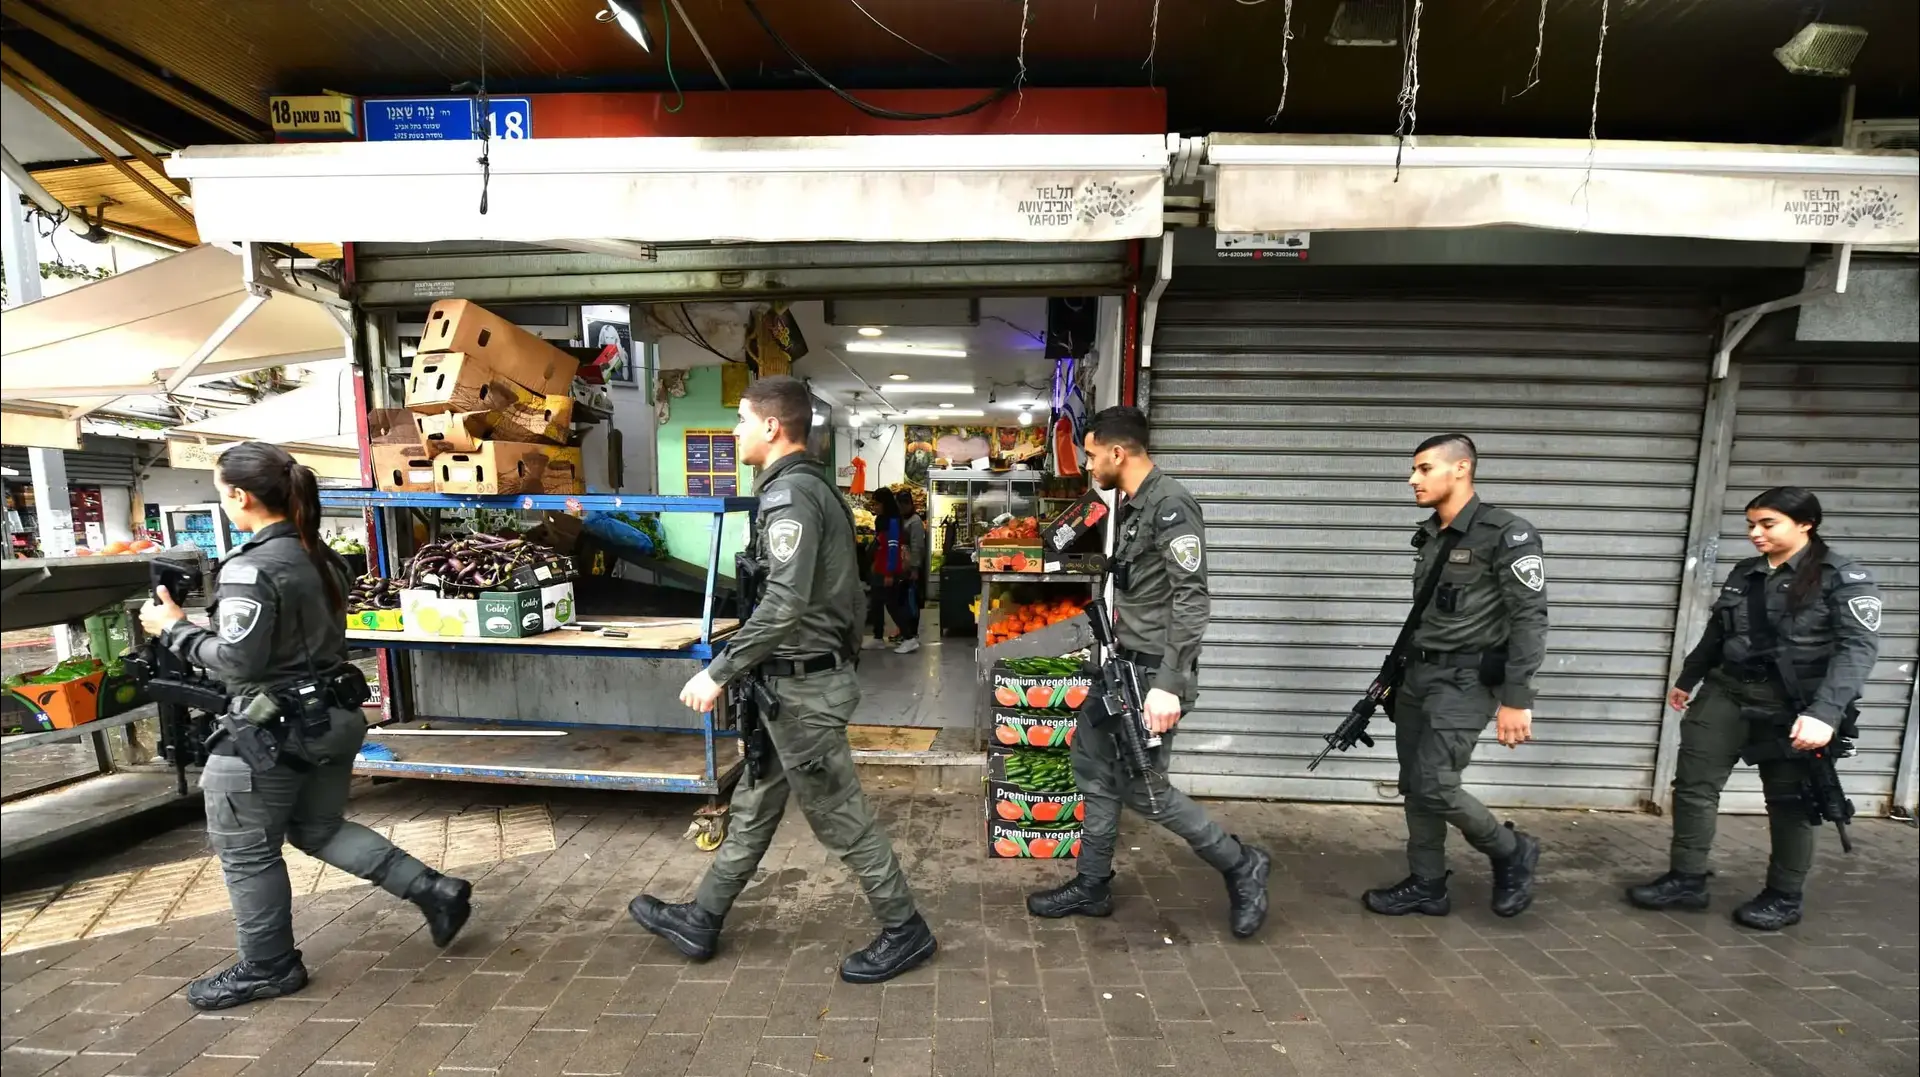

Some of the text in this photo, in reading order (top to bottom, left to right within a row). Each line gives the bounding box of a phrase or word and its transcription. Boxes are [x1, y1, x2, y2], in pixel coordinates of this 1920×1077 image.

[272, 100, 341, 127] נוה שאנן 18
[485, 111, 524, 140] 18
[1036, 184, 1073, 199] TEL תל
[1803, 187, 1840, 201] TEL תל
[1018, 201, 1073, 213] AVIV אביב
[1783, 202, 1840, 213] AVIV אביב
[1028, 214, 1073, 226] YAFO יפו
[1794, 214, 1839, 226] YAFO יפו
[485, 603, 512, 615] Goldy
[521, 597, 539, 608] Goldy
[994, 674, 1092, 689] Premium vegetables
[37, 714, 49, 722] 36
[995, 713, 1038, 726] Premium
[996, 788, 1086, 804] Premium vegeta
[994, 825, 1041, 839] Premium
